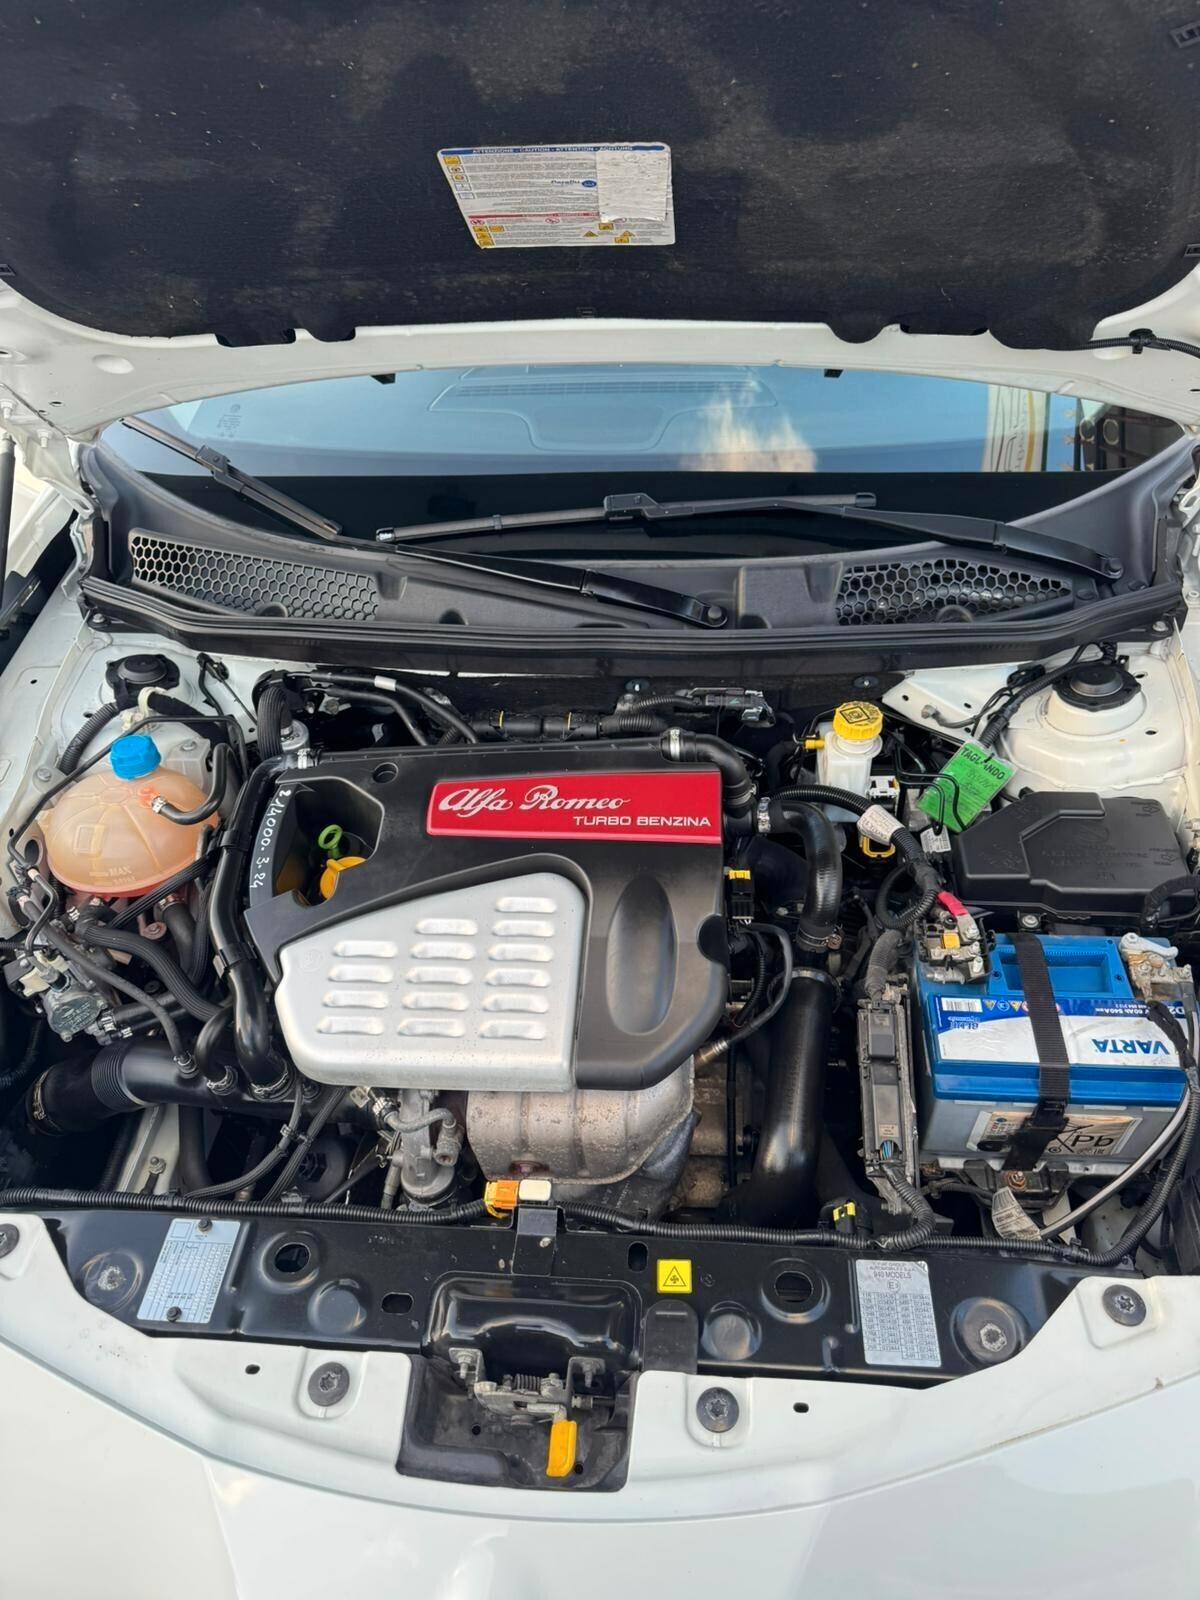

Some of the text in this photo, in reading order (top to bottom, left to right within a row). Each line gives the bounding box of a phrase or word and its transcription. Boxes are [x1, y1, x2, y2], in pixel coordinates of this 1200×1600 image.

[438, 784, 630, 818] Alfa Romeo
[573, 815, 711, 828] TURBO BENZINA
[1091, 1038, 1170, 1055] VARTA
[1071, 1134, 1115, 1148] Pb
[885, 1271, 912, 1279] MODELS
